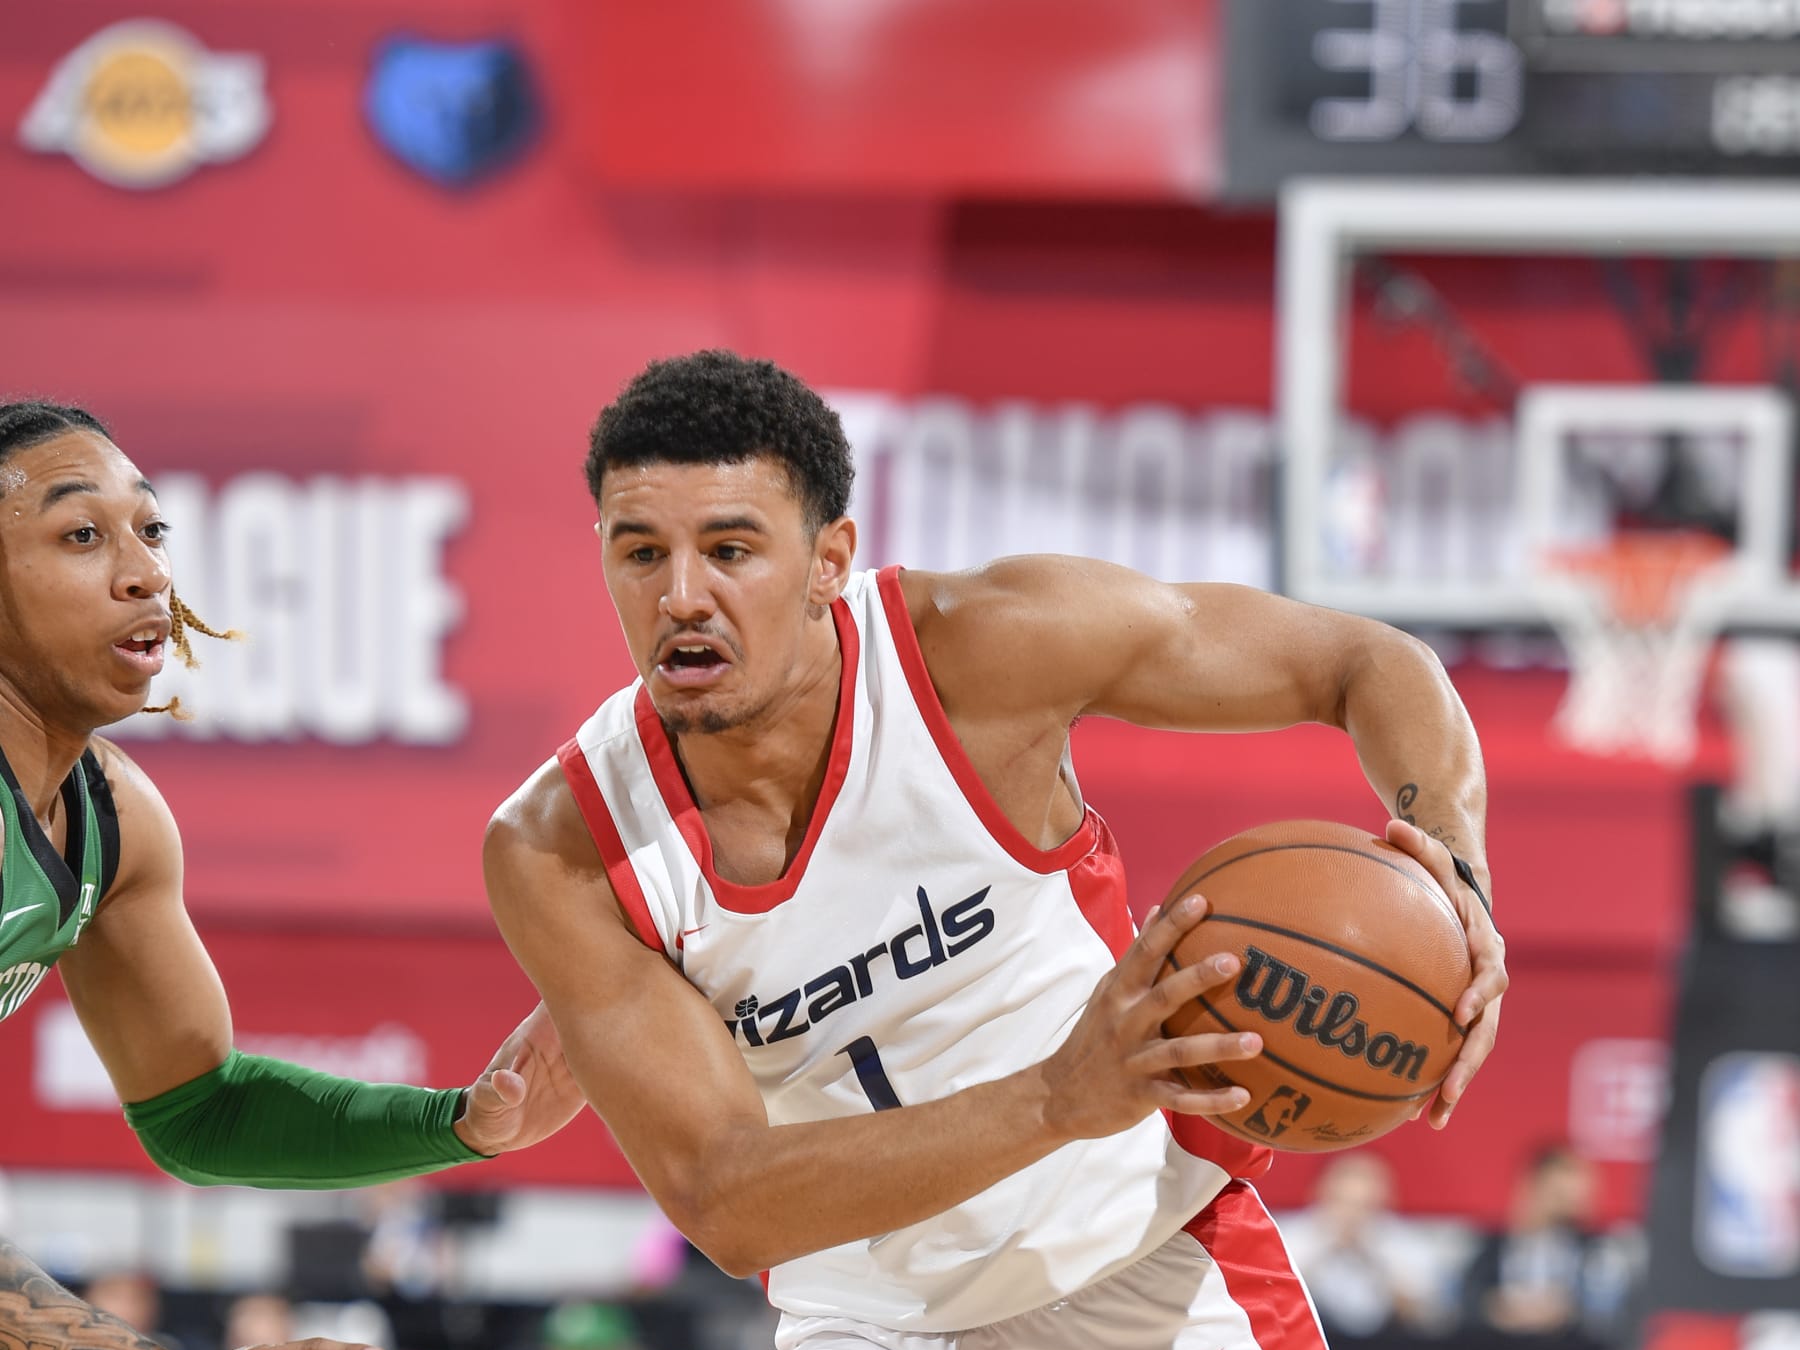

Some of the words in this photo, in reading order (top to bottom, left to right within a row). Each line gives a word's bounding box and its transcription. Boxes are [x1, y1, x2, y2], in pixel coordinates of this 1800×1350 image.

[724, 884, 995, 1047] izards
[1236, 945, 1429, 1082] Wilson
[834, 1035, 902, 1112] 1
